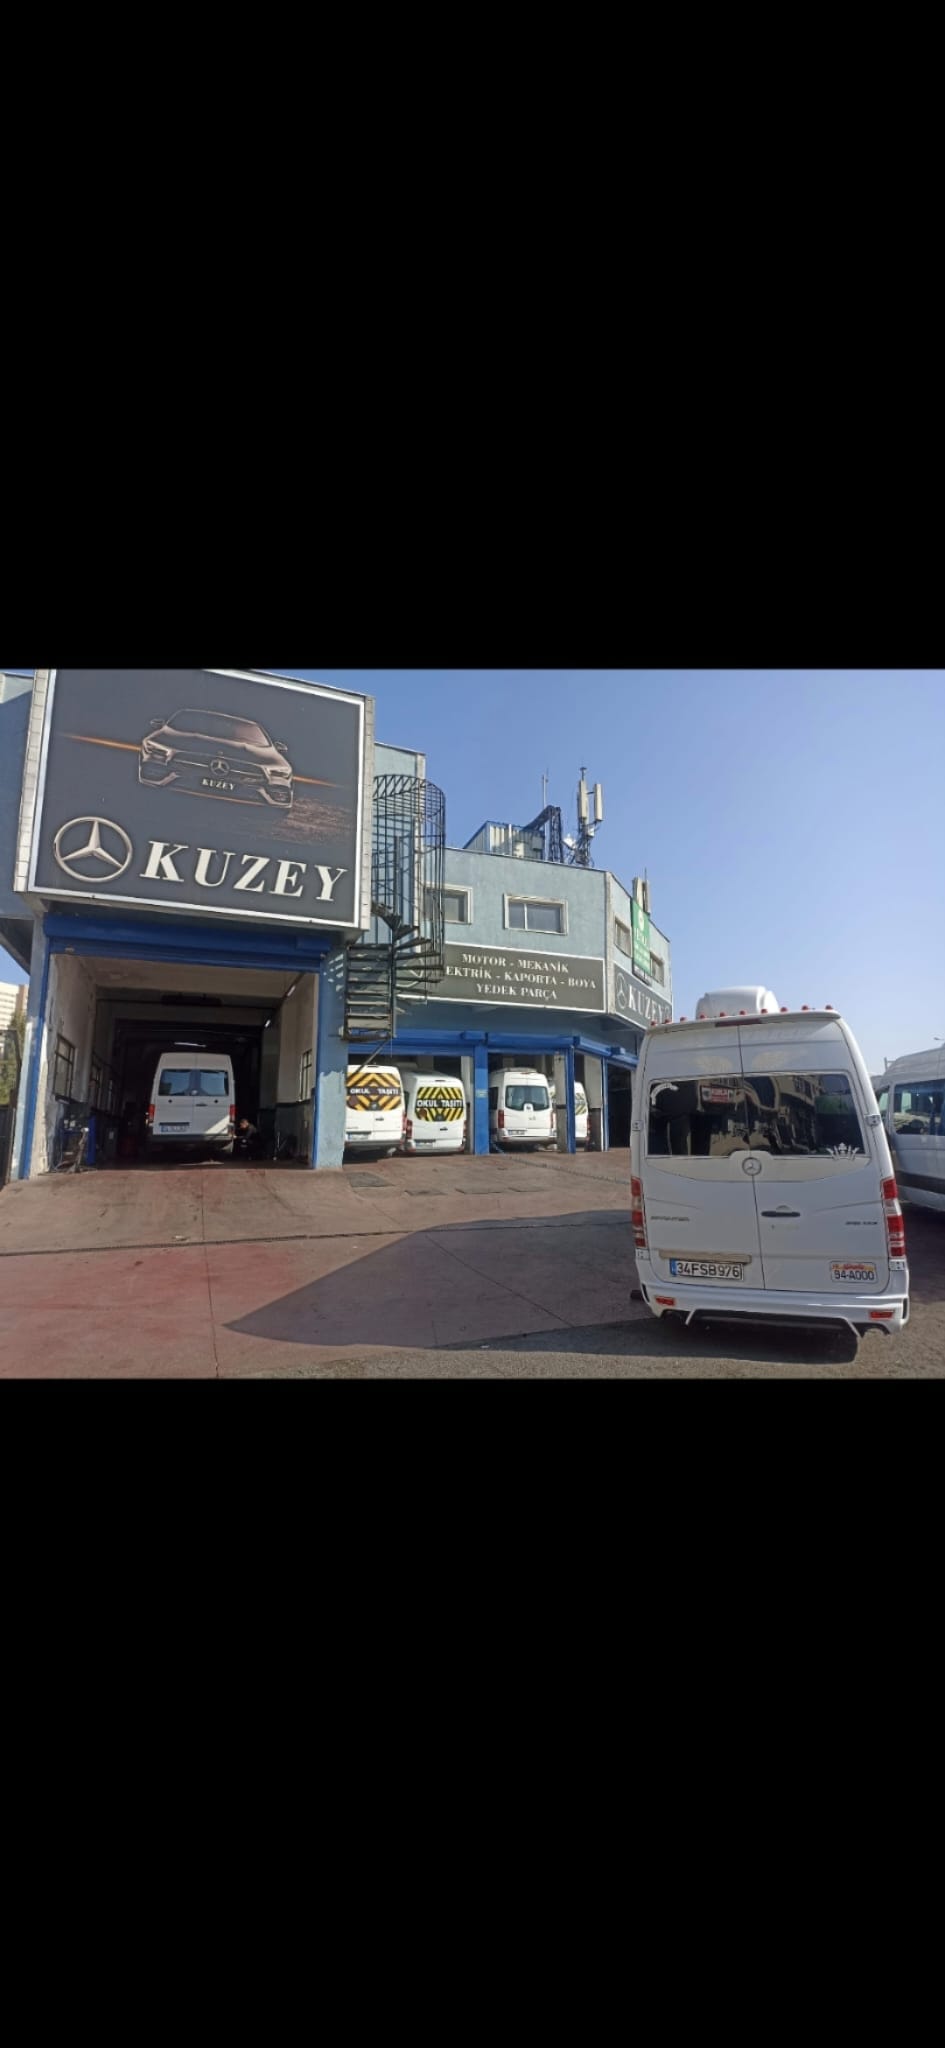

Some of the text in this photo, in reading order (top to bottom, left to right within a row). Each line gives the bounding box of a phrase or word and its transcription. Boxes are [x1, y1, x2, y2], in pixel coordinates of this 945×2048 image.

[202, 778, 235, 791] KUZEY
[139, 840, 348, 902] KUZEY
[462, 953, 506, 967] MOTOR
[518, 958, 569, 973] MEKANİK
[446, 965, 492, 979] EKTRİK
[504, 971, 557, 986] KAPORTA
[568, 977, 596, 990] BOYA
[476, 983, 558, 1001] YEDEK PARÇA
[628, 984, 664, 1024] KUZEY
[417, 1099, 438, 1107] OKUL
